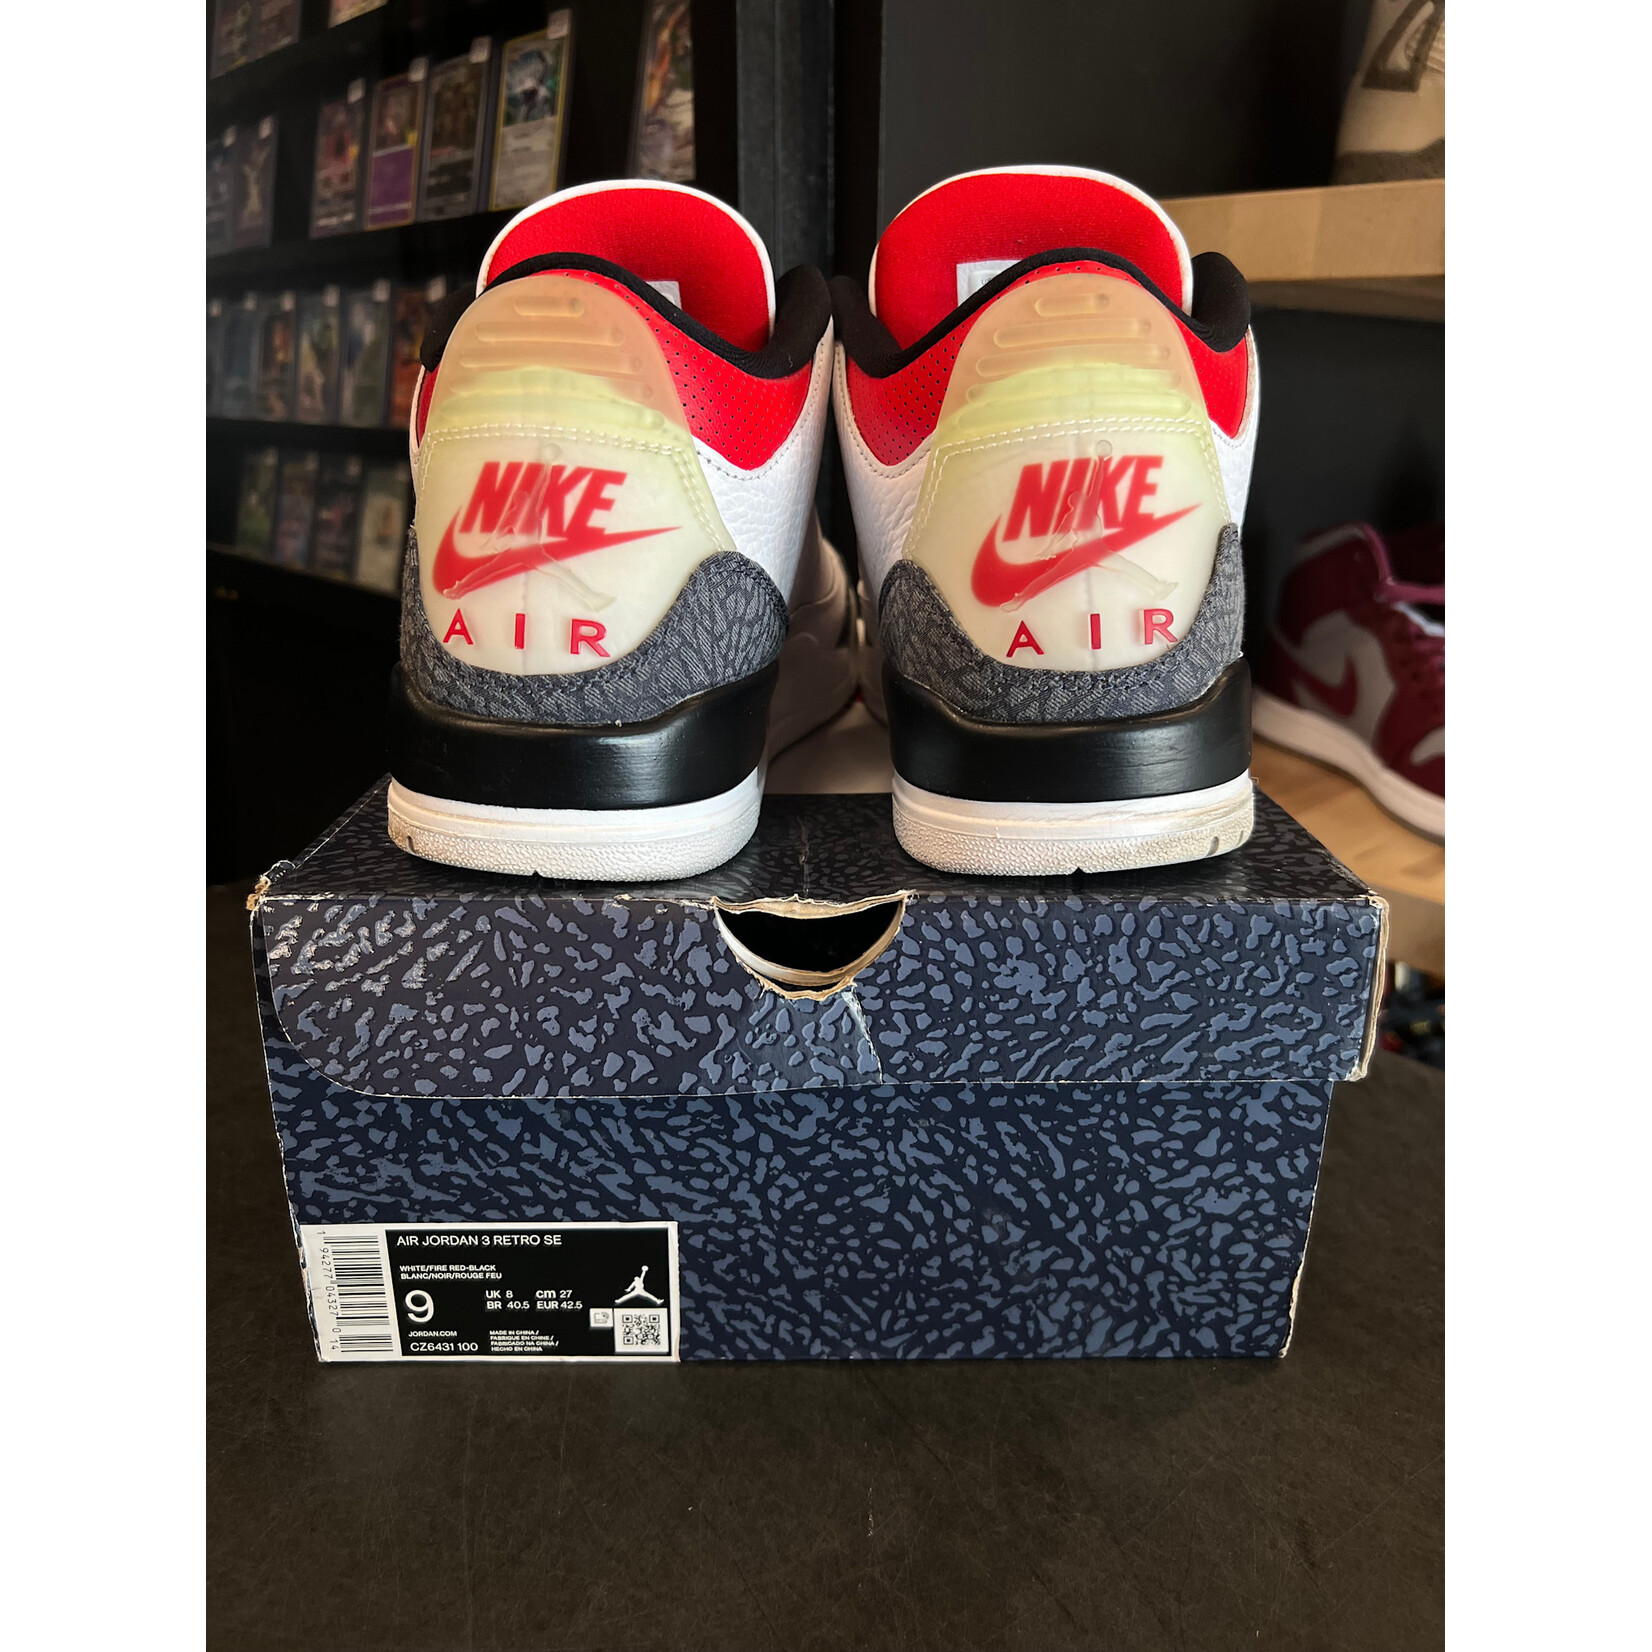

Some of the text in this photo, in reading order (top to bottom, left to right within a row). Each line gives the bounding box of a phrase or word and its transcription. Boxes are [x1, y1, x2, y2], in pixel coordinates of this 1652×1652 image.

[457, 461, 628, 538] NIKE
[1001, 454, 1163, 543] NIKE
[443, 608, 611, 658] AIR
[1006, 608, 1178, 658] AIR
[397, 1235, 562, 1246] AIR JORDAN 3 RETRO SE
[320, 1247, 333, 1279] 94277
[449, 1264, 496, 1272] RED-BLACK
[400, 1272, 484, 1280] BLANC/NOIR/ROUGE
[485, 1290, 514, 1299] UK 8
[535, 1290, 573, 1299] cm 27
[325, 1285, 339, 1316] 04327
[405, 1289, 434, 1323] 9
[486, 1301, 530, 1310] BR 40.5
[537, 1300, 583, 1309] EUR 42.5
[410, 1342, 478, 1352] CZ6431 100
